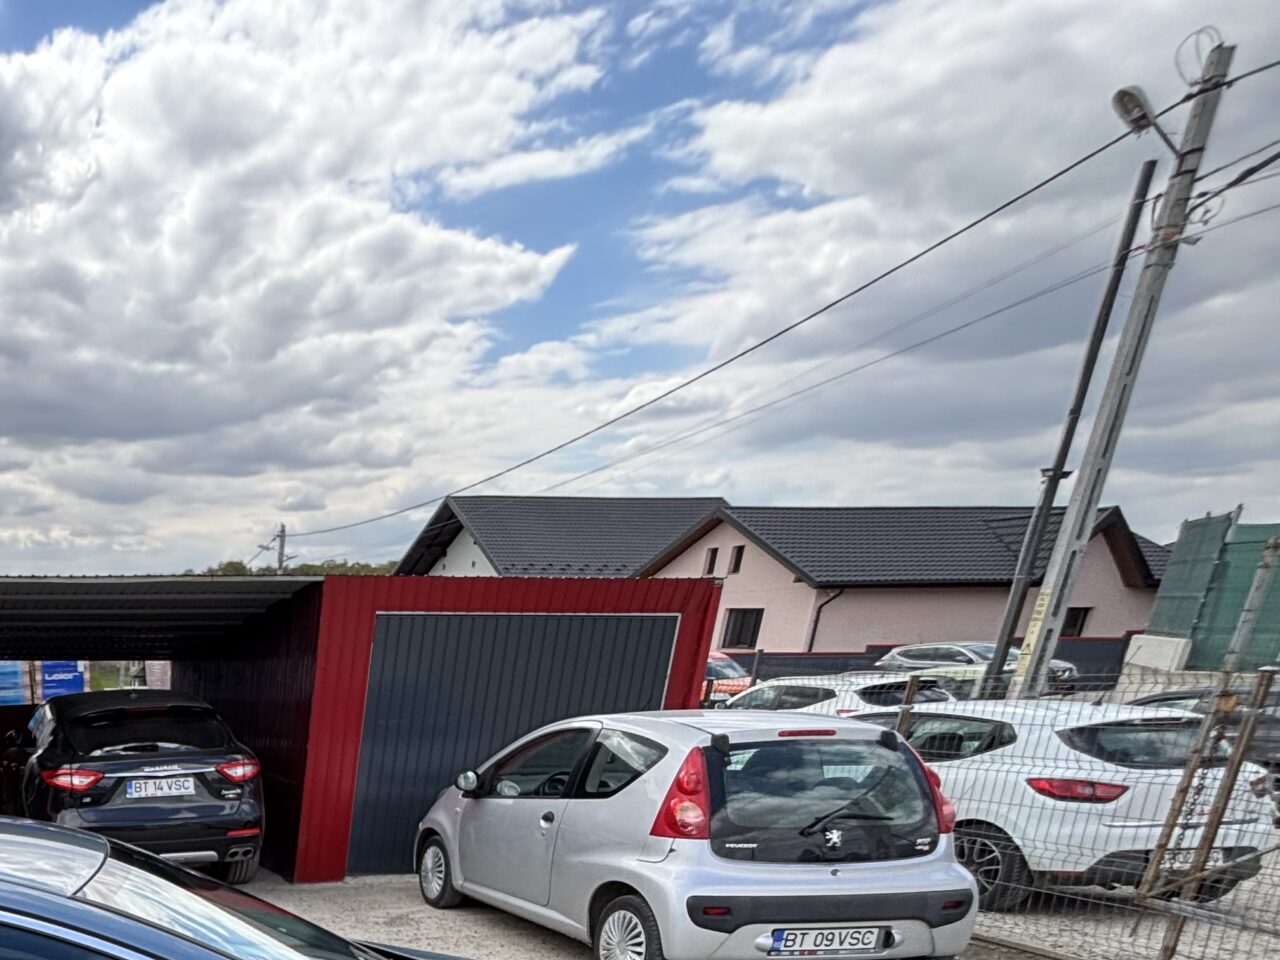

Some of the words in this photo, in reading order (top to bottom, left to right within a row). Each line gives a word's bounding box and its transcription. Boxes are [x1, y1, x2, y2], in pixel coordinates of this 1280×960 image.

[133, 779, 149, 794] BT
[153, 779, 164, 792] 14
[166, 777, 191, 791] VSC
[783, 932, 809, 948] BT
[813, 931, 836, 948] 09
[838, 930, 875, 947] VSC
